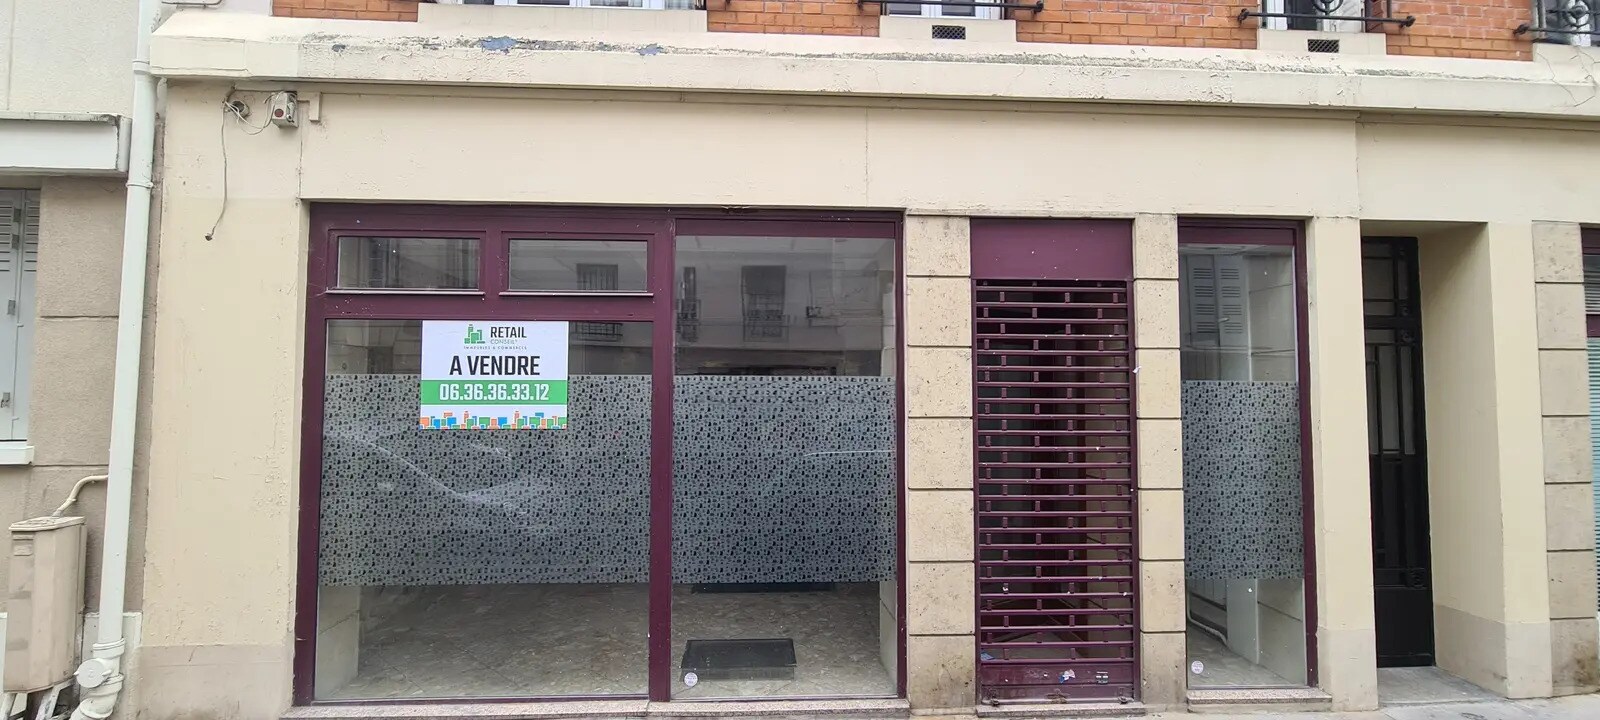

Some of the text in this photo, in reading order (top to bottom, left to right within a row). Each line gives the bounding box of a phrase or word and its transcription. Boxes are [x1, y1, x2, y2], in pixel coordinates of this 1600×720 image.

[490, 326, 527, 338] RETAIL
[449, 355, 541, 376] A VENDRE
[439, 383, 550, 401] 06.36.36.33.12
